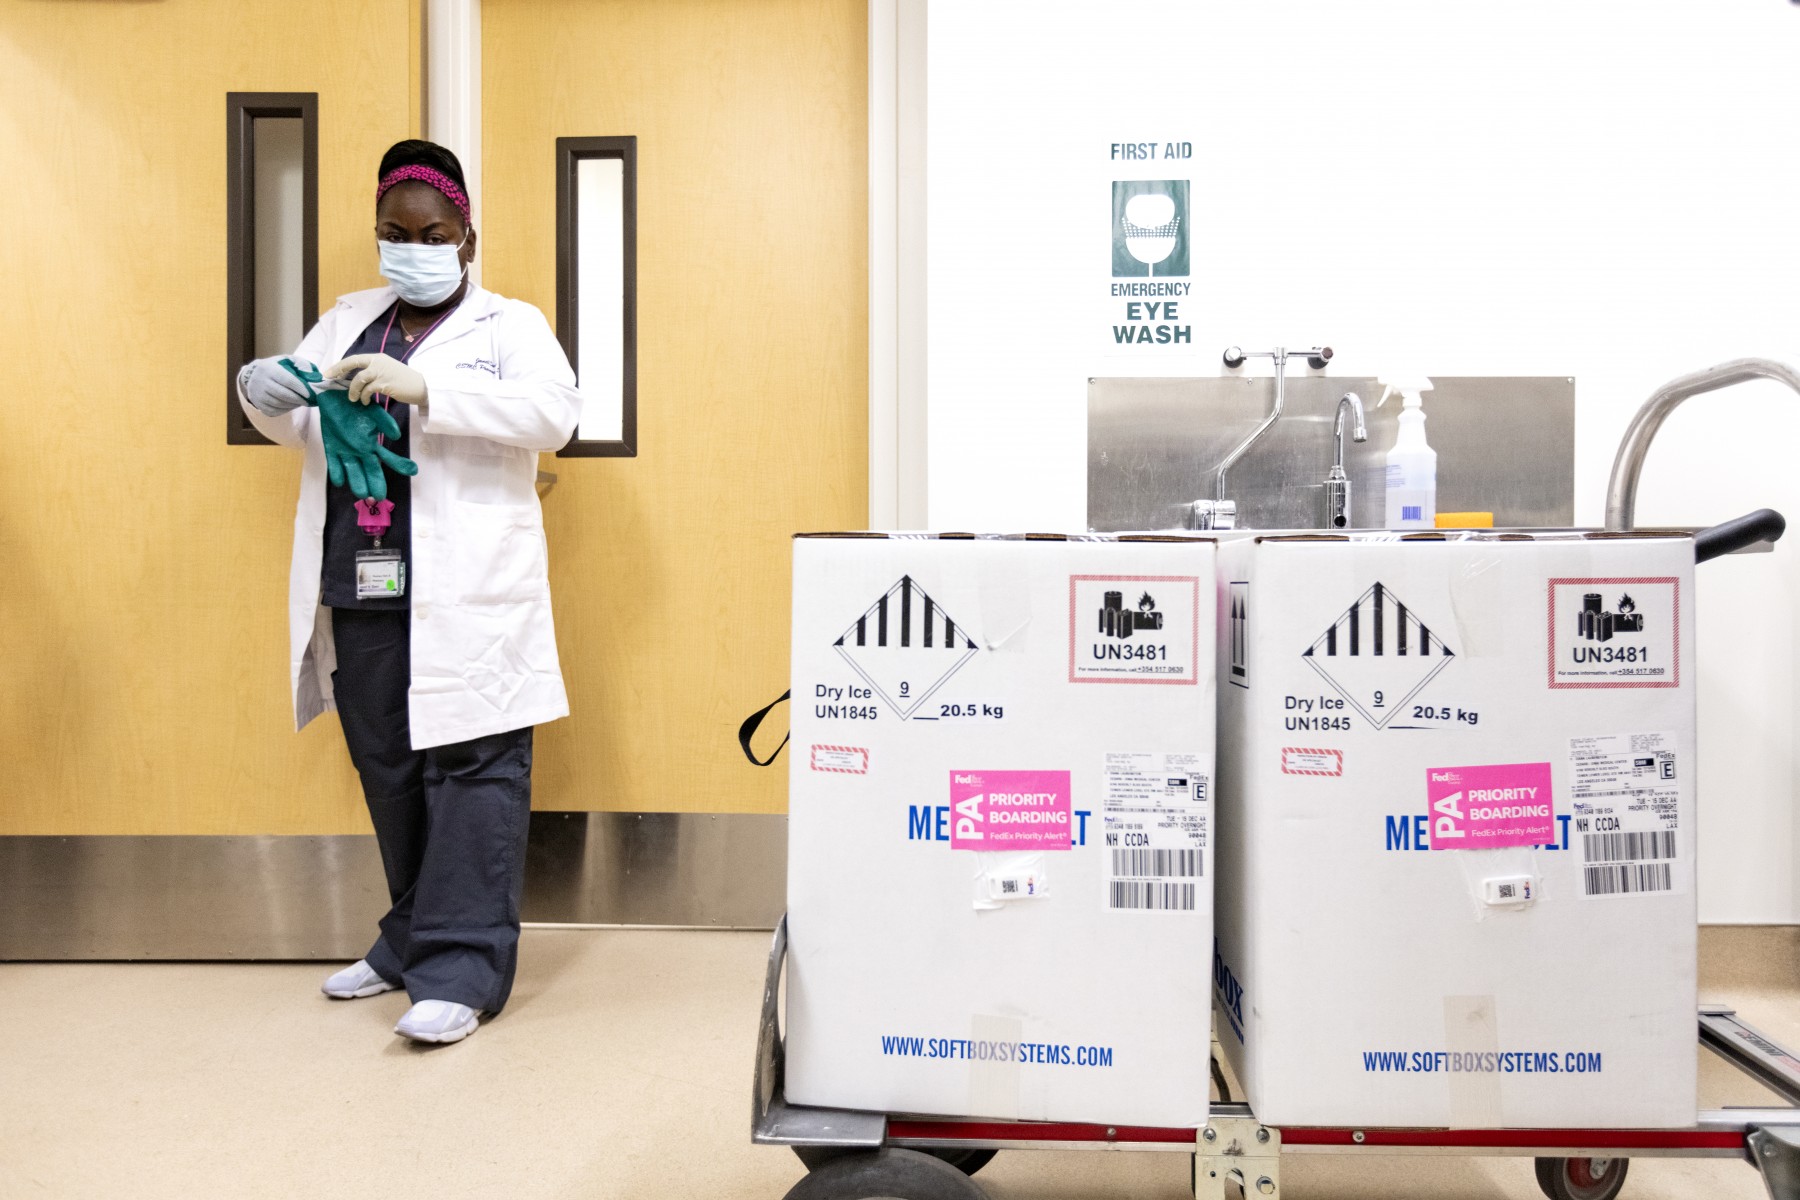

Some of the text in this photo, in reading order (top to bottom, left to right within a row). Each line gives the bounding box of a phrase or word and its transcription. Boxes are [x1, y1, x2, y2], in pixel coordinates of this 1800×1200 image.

[1111, 142, 1192, 160] FIRST AID
[1111, 283, 1191, 296] EMERGENCY
[1127, 301, 1179, 320] EYE
[1113, 325, 1192, 344] WASH
[1093, 644, 1166, 660] UN3481
[1573, 647, 1647, 663] UN3481
[816, 684, 871, 701] Dry Ice
[900, 681, 909, 694] 9
[1285, 696, 1344, 713] Dry Ice
[1374, 691, 1383, 704] 9
[816, 705, 877, 720] UN1845
[940, 704, 1004, 718] 20.5 kg
[1413, 706, 1478, 724] 20.5 kg
[1285, 717, 1350, 731] UN1845
[1664, 763, 1672, 777] E
[1197, 785, 1204, 798] E
[1468, 787, 1538, 802] PRIORITY
[989, 793, 1056, 806] PRIORITY
[956, 793, 984, 840] PA
[989, 811, 1067, 824] BOARDING
[1434, 791, 1465, 838] PA
[1469, 804, 1549, 821] BOARDING
[1472, 829, 1496, 837] FedEx
[1497, 827, 1525, 837] Priority
[1576, 817, 1620, 832] NH CCDA
[1015, 832, 1042, 841] Priority
[1106, 833, 1149, 846] NH CCDA
[882, 1036, 1113, 1067] WWW.SOFTBOXSYSTEMS.COM
[1363, 1051, 1602, 1073] WWW.SOFTBOXSYSTEMS.COM
